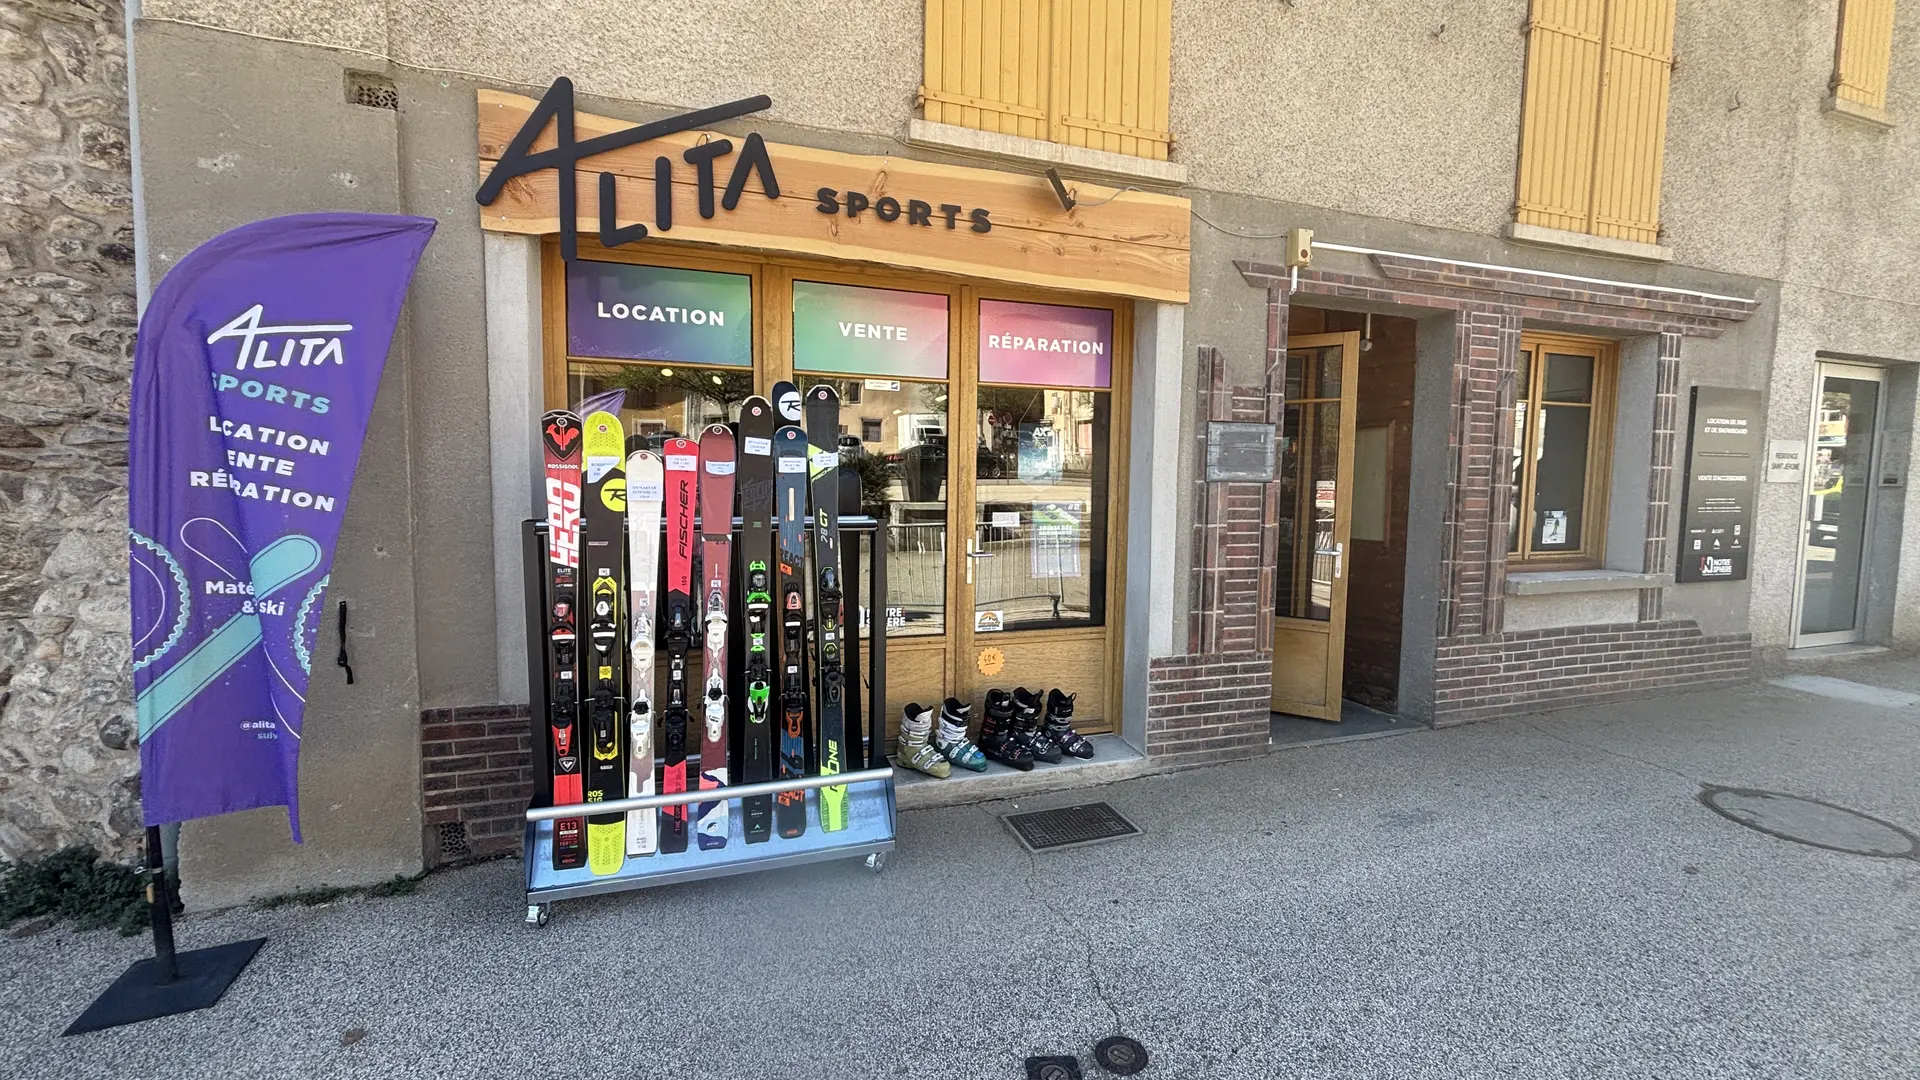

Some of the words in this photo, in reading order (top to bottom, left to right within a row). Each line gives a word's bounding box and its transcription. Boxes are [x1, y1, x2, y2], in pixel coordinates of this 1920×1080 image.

[476, 76, 780, 262] ALITA
[815, 187, 992, 234] SPORTS
[597, 301, 725, 327] LOCATION
[207, 303, 353, 370] ALITA
[838, 321, 909, 343] VENTE
[988, 332, 1105, 356] RÉPARATION
[227, 449, 295, 476] ENTE
[679, 480, 689, 559] FISCHER
[1714, 558, 1731, 566] NOTRE
